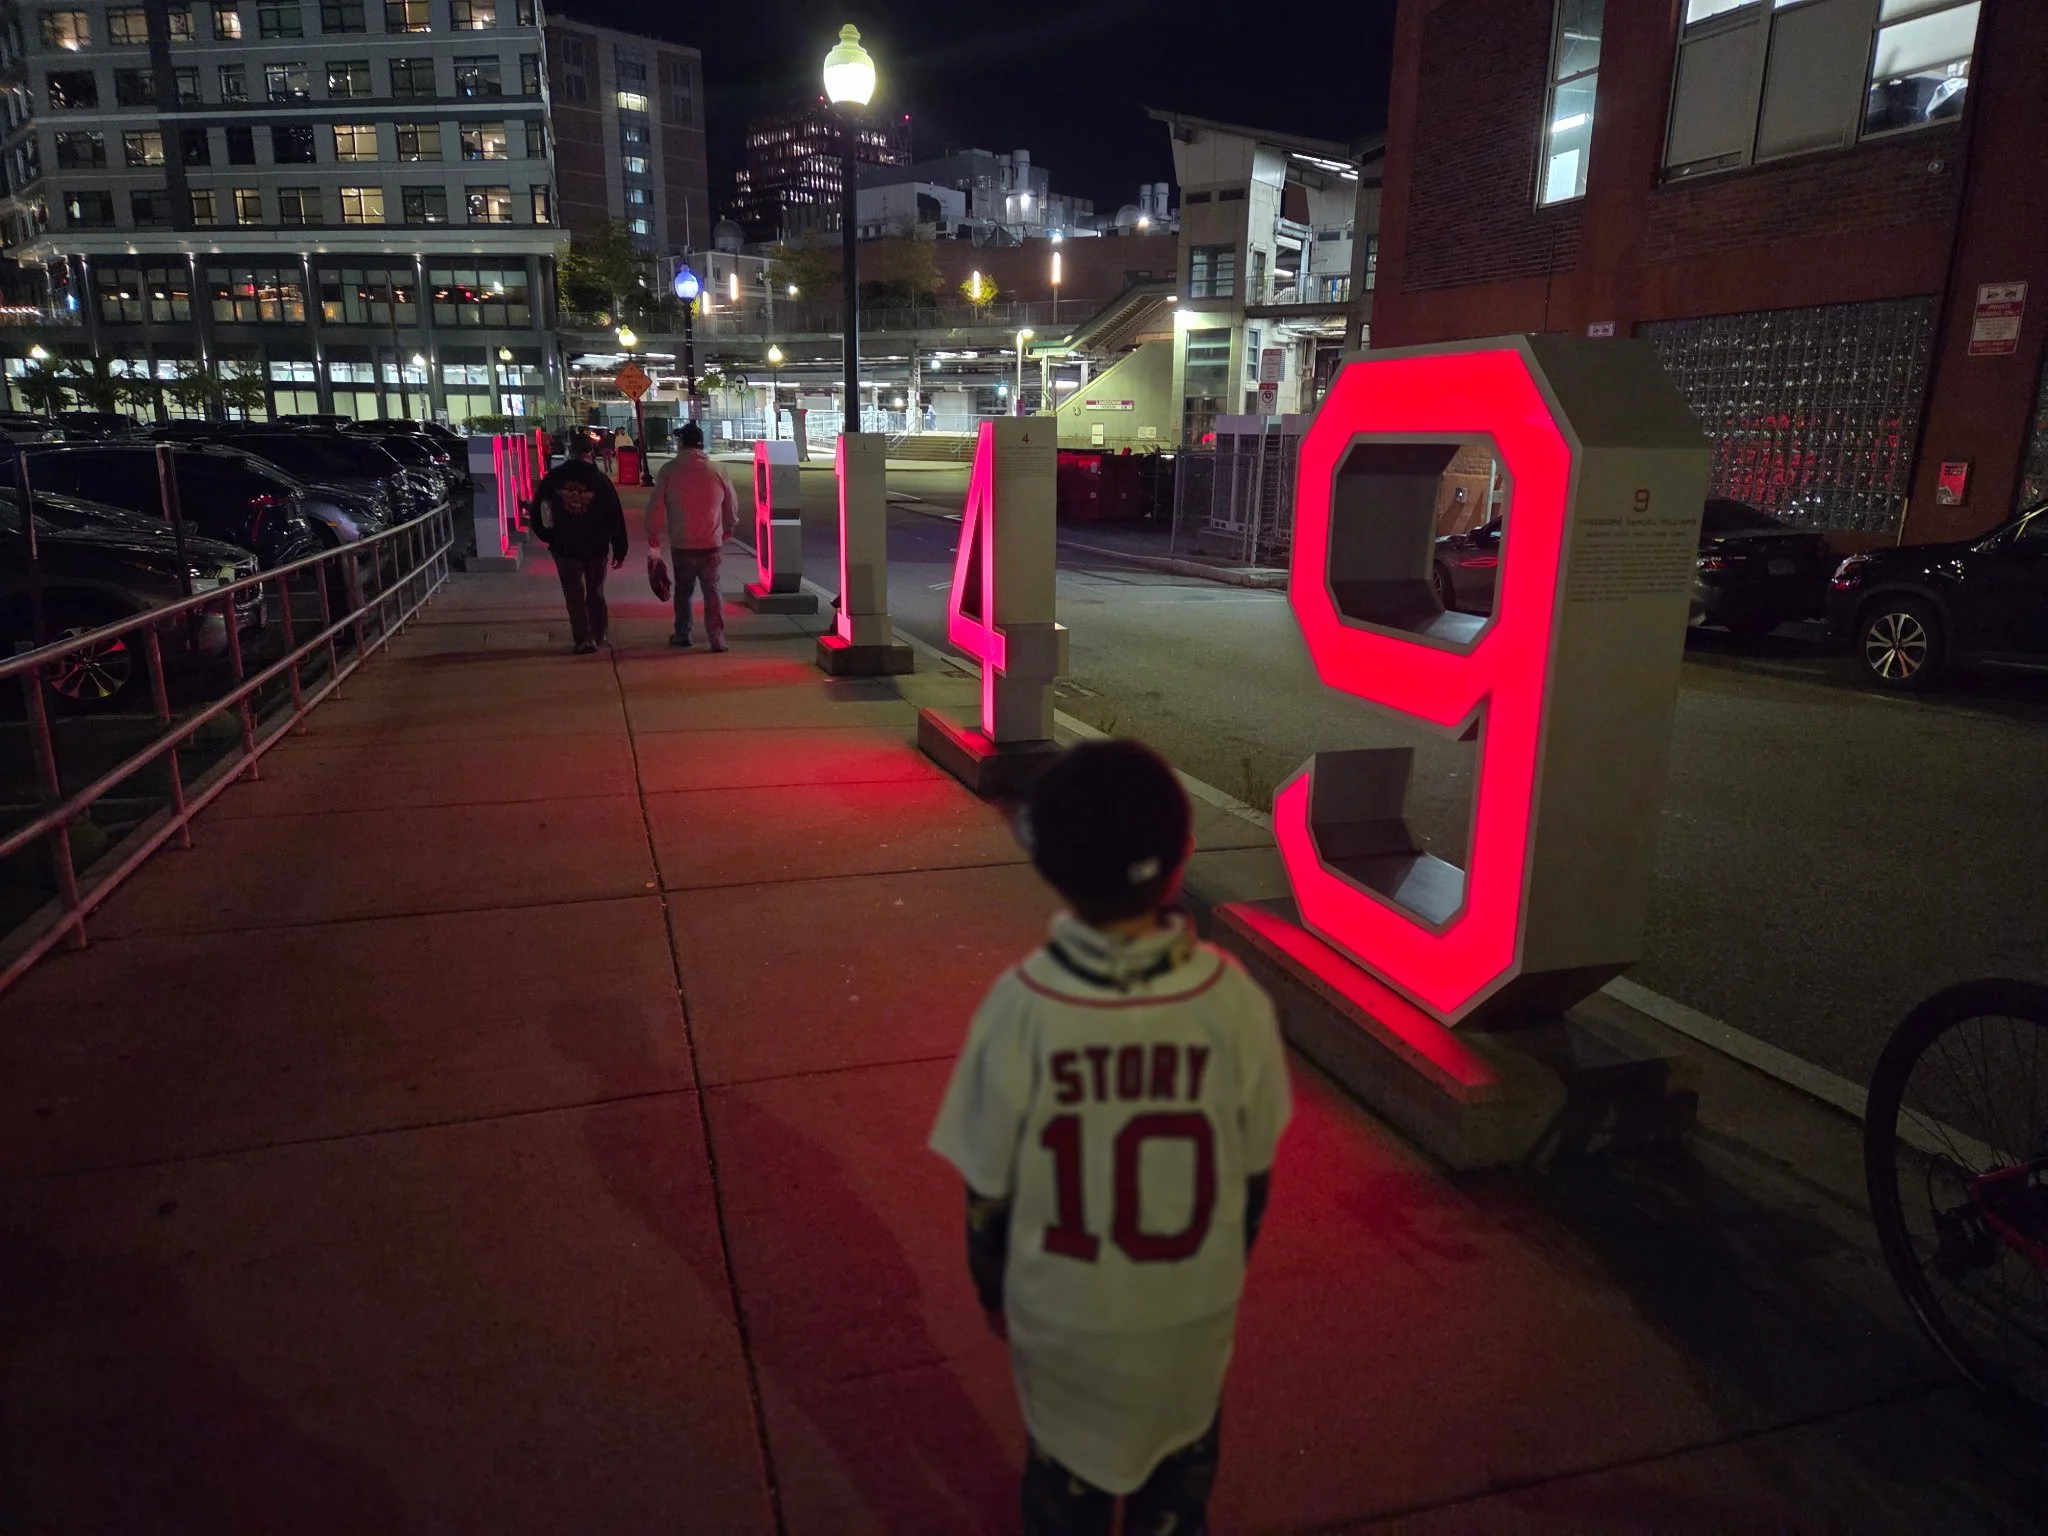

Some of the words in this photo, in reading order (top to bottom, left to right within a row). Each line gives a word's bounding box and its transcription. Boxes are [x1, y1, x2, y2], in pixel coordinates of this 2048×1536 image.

[1021, 433, 1030, 444] 4
[1633, 488, 1650, 513] 9
[754, 440, 774, 592] 8
[949, 421, 1007, 741] 4
[1274, 348, 1574, 1017] 9
[1051, 1043, 1209, 1104] STORY
[1039, 1111, 1218, 1264] 10
